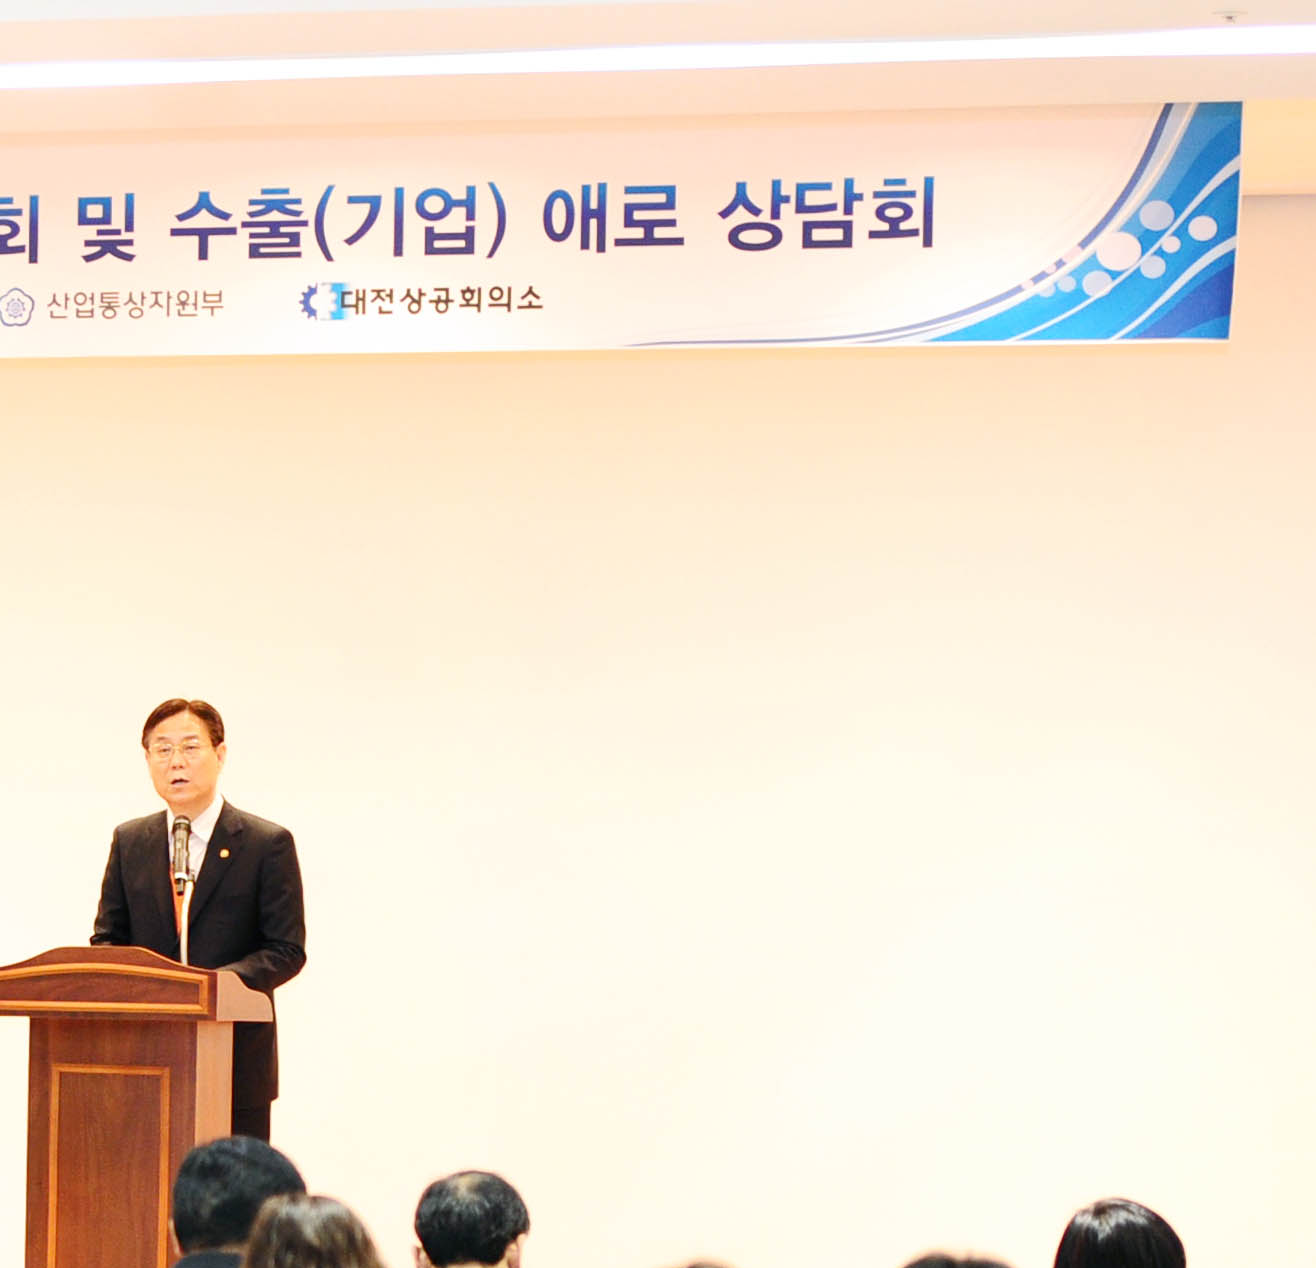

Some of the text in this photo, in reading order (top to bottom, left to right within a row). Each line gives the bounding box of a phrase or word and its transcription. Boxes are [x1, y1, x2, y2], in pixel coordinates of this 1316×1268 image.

[77, 191, 136, 264] 및
[169, 181, 508, 263] 수출(기업)
[542, 182, 686, 254] 애로
[717, 176, 936, 253] 상담회
[47, 289, 225, 321] 산업통상자원부
[338, 284, 545, 317] 대전상공회의소
